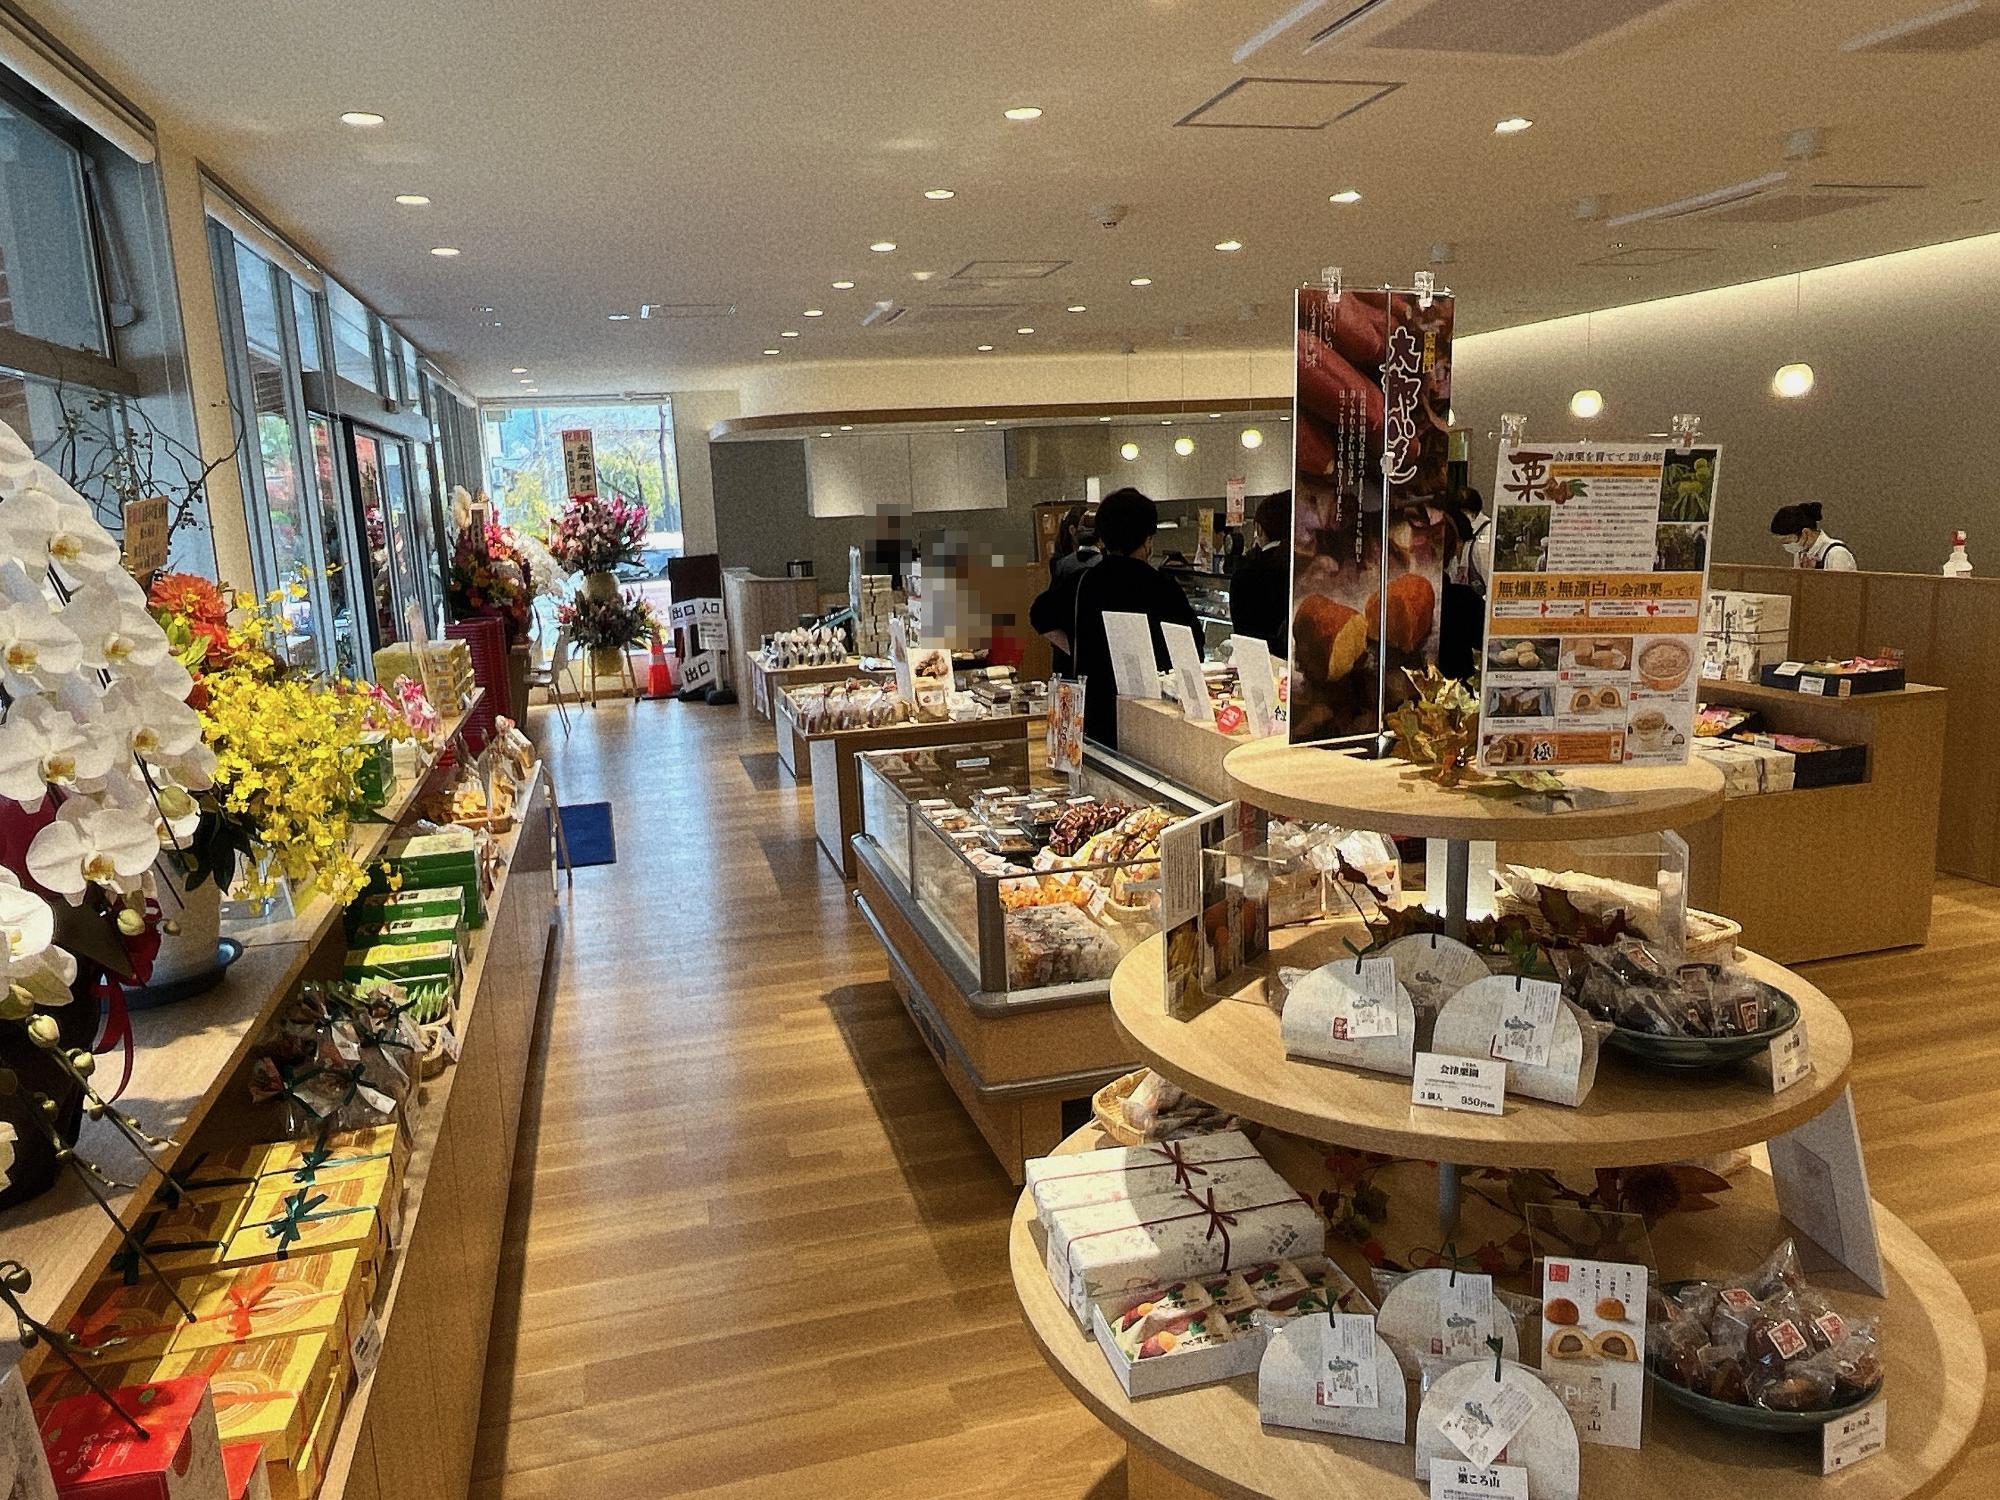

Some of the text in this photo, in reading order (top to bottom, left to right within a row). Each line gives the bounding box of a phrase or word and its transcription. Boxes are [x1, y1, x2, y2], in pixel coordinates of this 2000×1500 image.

[1503, 451, 1553, 503] 栗
[672, 604, 696, 620] 出口
[702, 602, 720, 614] 入口
[685, 661, 711, 684] 出口
[1458, 1473, 1500, 1488] 栗ころ山
